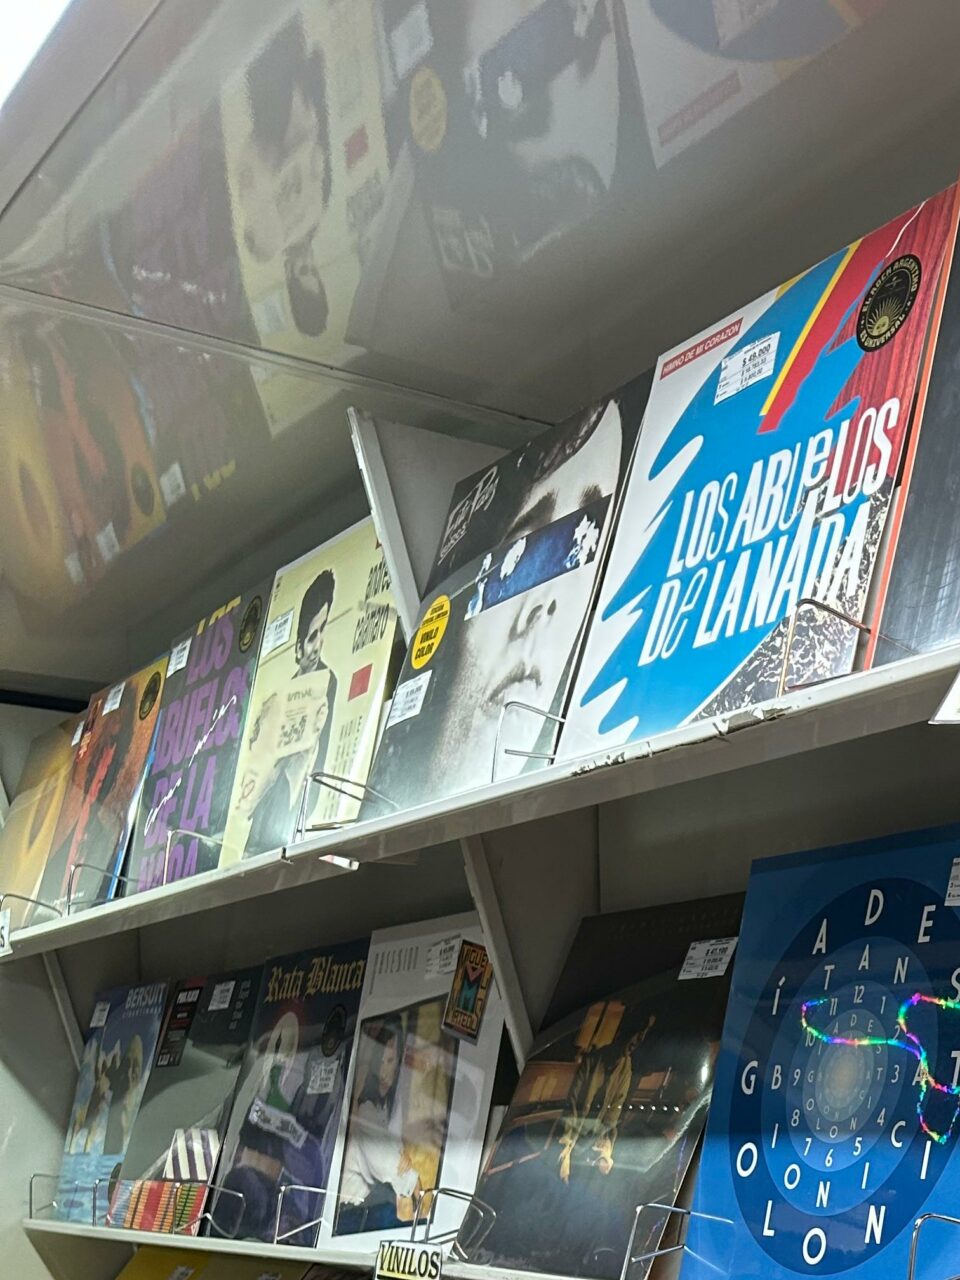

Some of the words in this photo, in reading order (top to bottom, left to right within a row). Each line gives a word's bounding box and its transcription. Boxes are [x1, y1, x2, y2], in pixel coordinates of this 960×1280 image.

[704, 323, 740, 350] CORAZON
[668, 472, 738, 578] LOS
[744, 502, 871, 636] NADA
[415, 642, 434, 660] COLOR
[263, 964, 305, 1003] Rata
[303, 953, 365, 1001] Blanca
[125, 982, 166, 1009] BERSUIT
[853, 985, 865, 1004] 12
[830, 998, 838, 1016] 11
[880, 996, 886, 1015] 1
[892, 1025, 901, 1041] 2
[793, 1068, 801, 1086] 9
[891, 1065, 899, 1083] 3
[791, 1109, 800, 1127] 8
[877, 1108, 886, 1126] 4
[803, 1138, 812, 1156] 7
[853, 1137, 862, 1156] 5
[825, 1148, 834, 1167] 6
[380, 1242, 440, 1280] VINILOS
